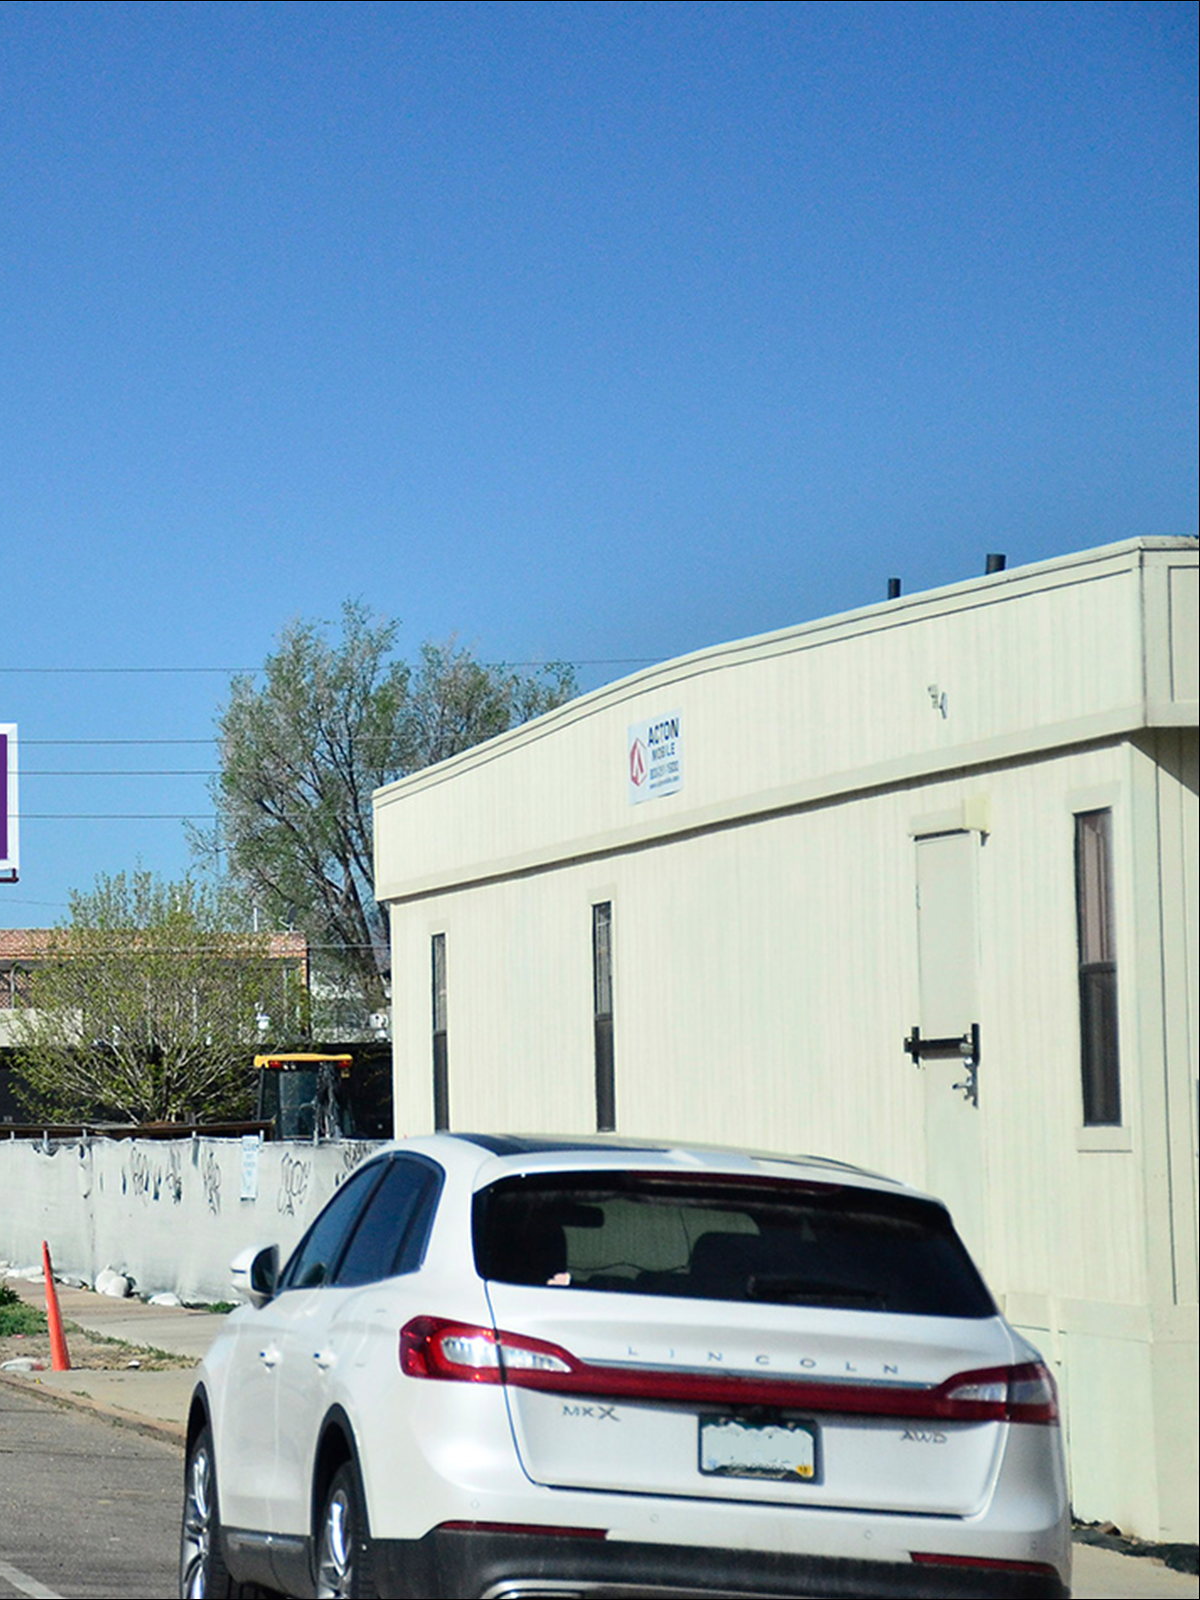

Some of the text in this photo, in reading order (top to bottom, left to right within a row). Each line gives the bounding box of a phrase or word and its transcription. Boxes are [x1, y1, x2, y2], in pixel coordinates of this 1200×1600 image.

[648, 718, 679, 746] ACTON
[652, 742, 675, 760] MOBILE
[627, 1345, 899, 1375] LINCOLN
[562, 1405, 622, 1422] MKX
[900, 1428, 948, 1444] AWD
